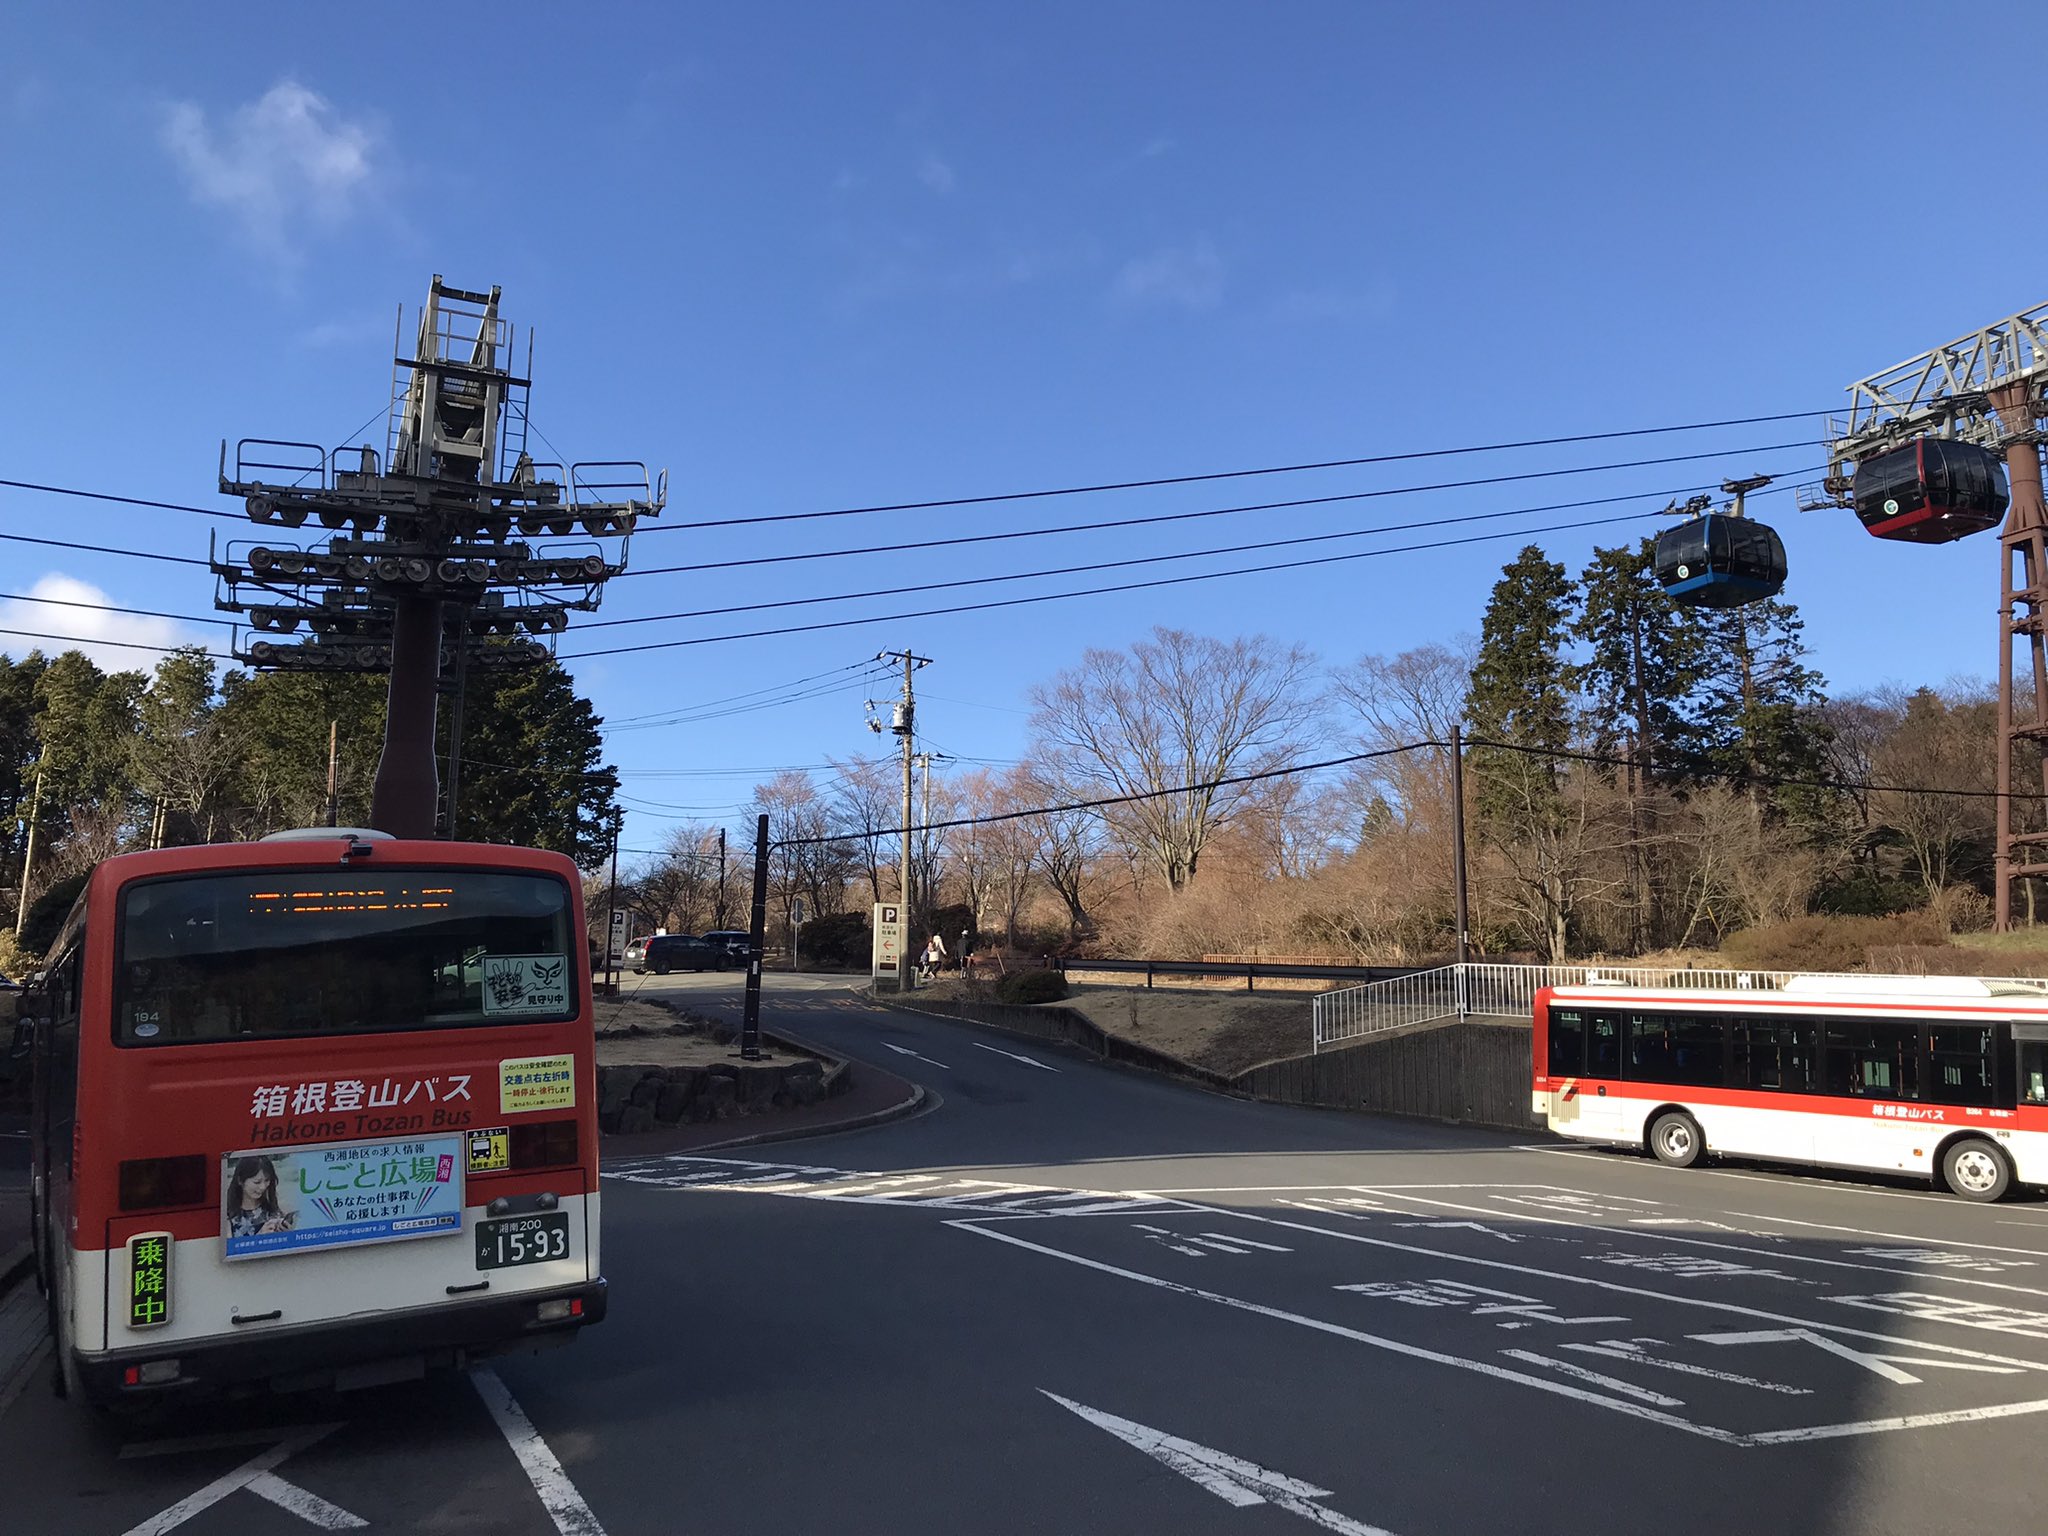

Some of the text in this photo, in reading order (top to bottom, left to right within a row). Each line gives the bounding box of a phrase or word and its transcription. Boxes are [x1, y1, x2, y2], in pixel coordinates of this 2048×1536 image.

[885, 909, 895, 921] P
[528, 993, 564, 1006] 見守り中
[134, 1011, 160, 1022] 194
[504, 1070, 570, 1086] 交差点右左折時
[250, 1074, 473, 1119] 箱根登山バス
[1872, 1103, 1944, 1120] 箱根登山バス
[250, 1108, 472, 1143] Hakone Tozan Bus
[324, 1143, 425, 1162] 西湘地区の求人情報
[300, 1155, 437, 1194] しごと広場
[438, 1158, 451, 1179] 西湘
[333, 1190, 418, 1208] あなたの仕事探し
[295, 1224, 386, 1241] https://seisho-square.jp
[481, 1247, 491, 1257] か
[497, 1228, 565, 1263] 15-93
[134, 1238, 165, 1324] 乗降中
